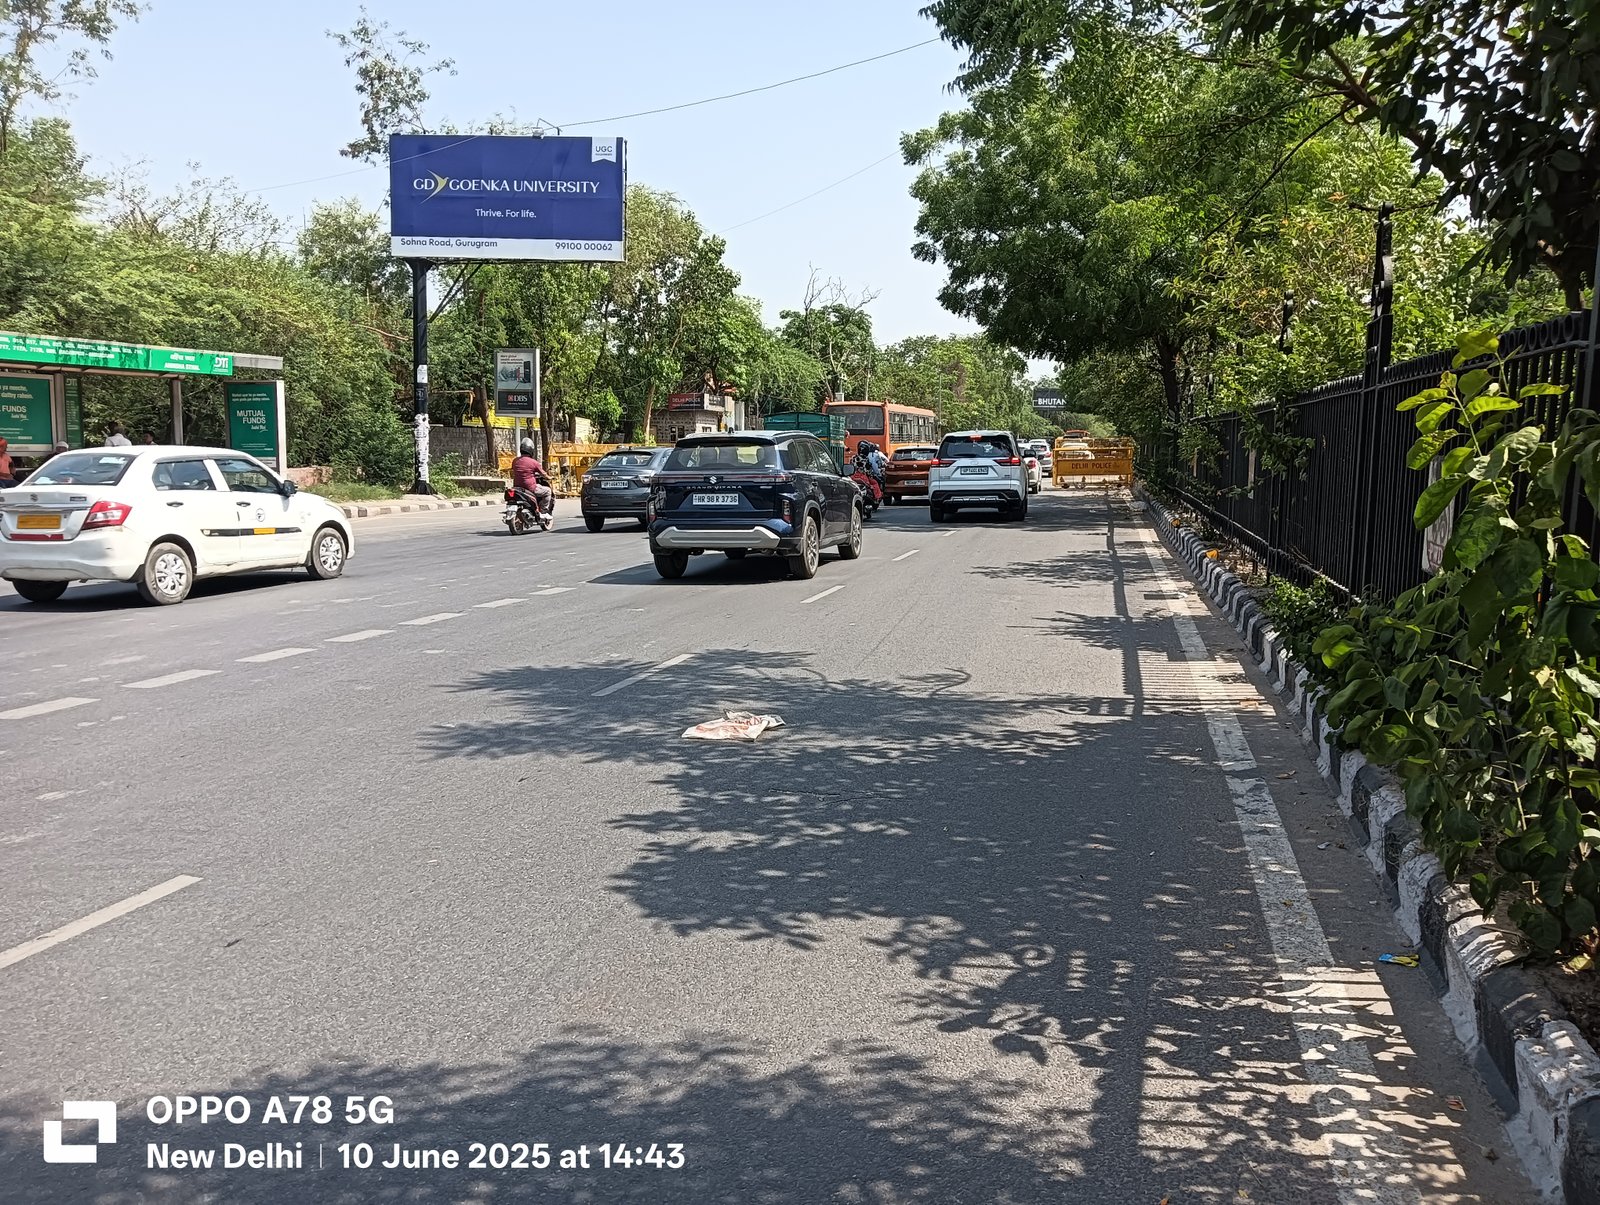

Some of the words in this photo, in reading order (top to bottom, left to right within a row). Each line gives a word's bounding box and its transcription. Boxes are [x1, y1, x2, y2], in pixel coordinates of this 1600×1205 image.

[595, 145, 613, 153] UGC
[413, 178, 435, 191] GD
[449, 179, 510, 192] GOENKA
[513, 180, 600, 194] UNIVERSITY
[475, 208, 504, 218] Thrive.
[506, 209, 520, 218] For
[521, 209, 537, 219] life.
[400, 238, 427, 247] Sohna
[429, 238, 454, 248] Road,
[455, 239, 498, 249] Gurugram
[555, 242, 582, 250] 99100
[584, 242, 613, 251] 00062
[2, 405, 27, 413] FUNDS
[697, 495, 705, 503] HR
[706, 495, 715, 503] 98
[715, 495, 720, 503] R
[721, 495, 738, 503] 3736
